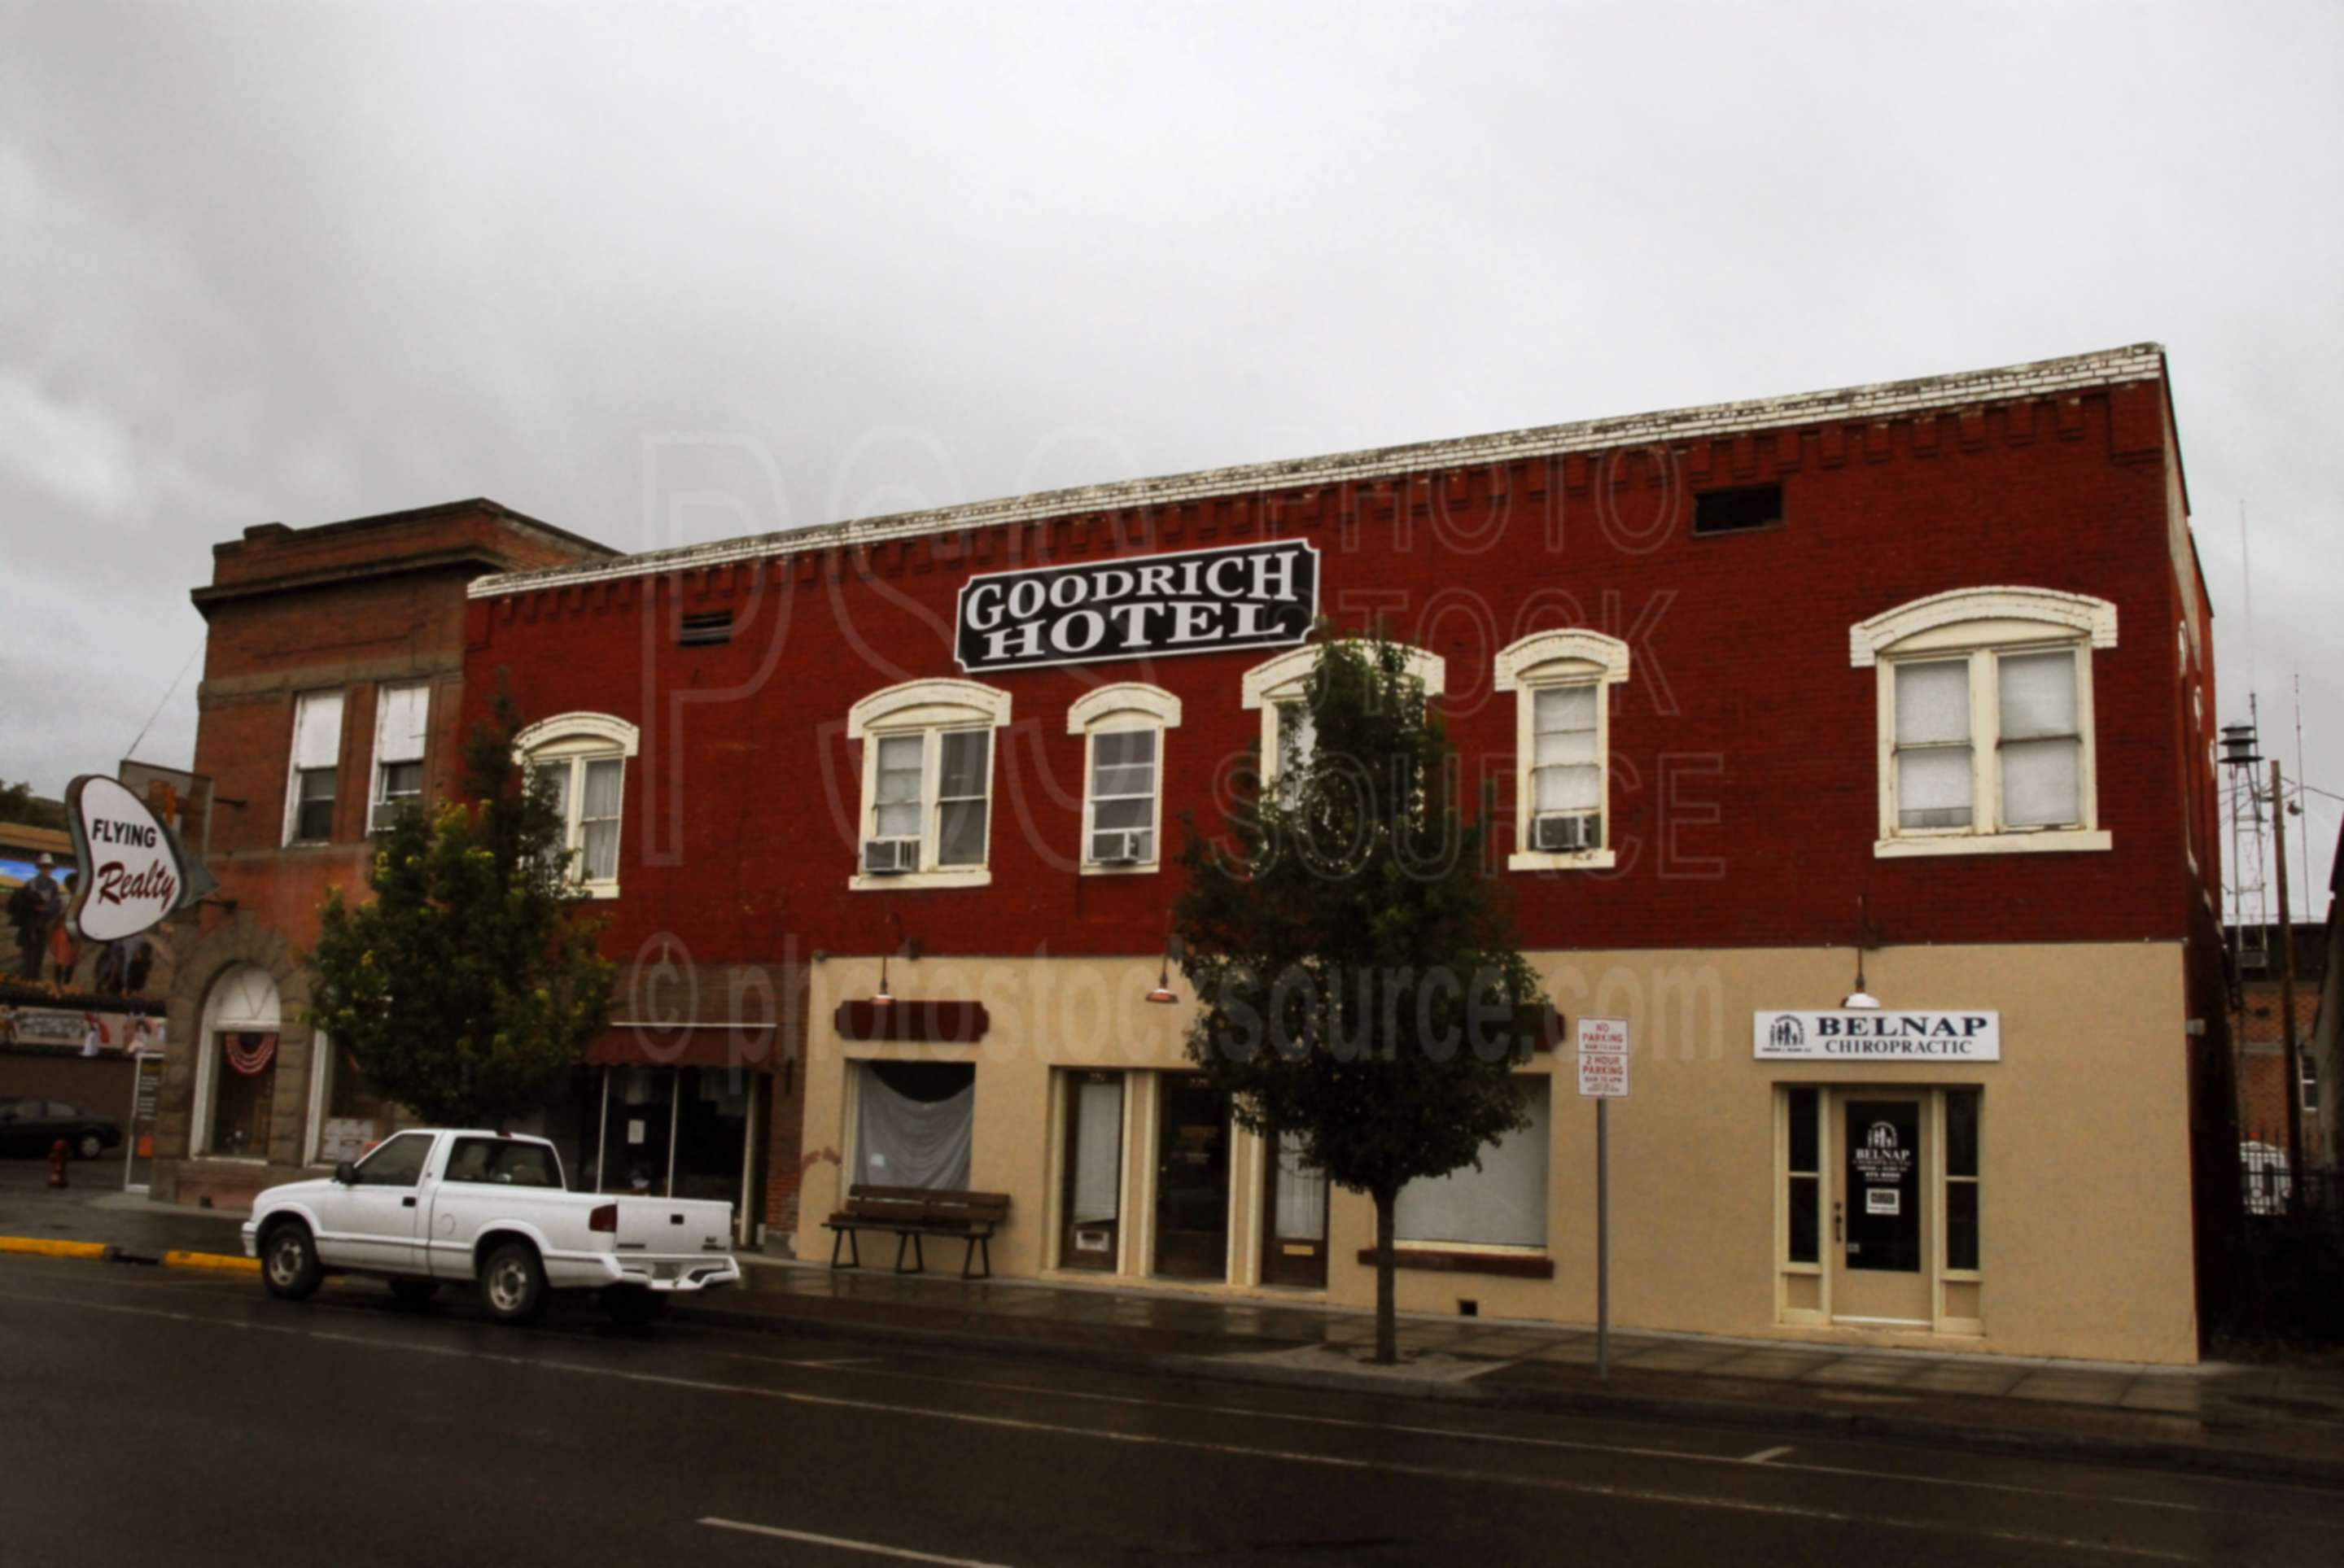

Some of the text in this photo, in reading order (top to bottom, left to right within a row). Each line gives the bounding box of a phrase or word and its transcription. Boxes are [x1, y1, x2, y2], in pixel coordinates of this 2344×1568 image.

[966, 551, 1299, 630] GOODRICH
[982, 601, 1286, 660] HOTEL
[92, 819, 156, 848] FLYING
[98, 858, 175, 912] Realty
[1597, 1023, 1609, 1032] NO
[1816, 1017, 1988, 1037] BELNAP
[1582, 1032, 1623, 1042] PARKING
[1825, 1040, 1972, 1054] CHIROPRACTIC
[1586, 1055, 1620, 1065] 2 HOUR
[1582, 1065, 1623, 1076] PARKING
[1856, 1148, 1910, 1160] BELNAP
